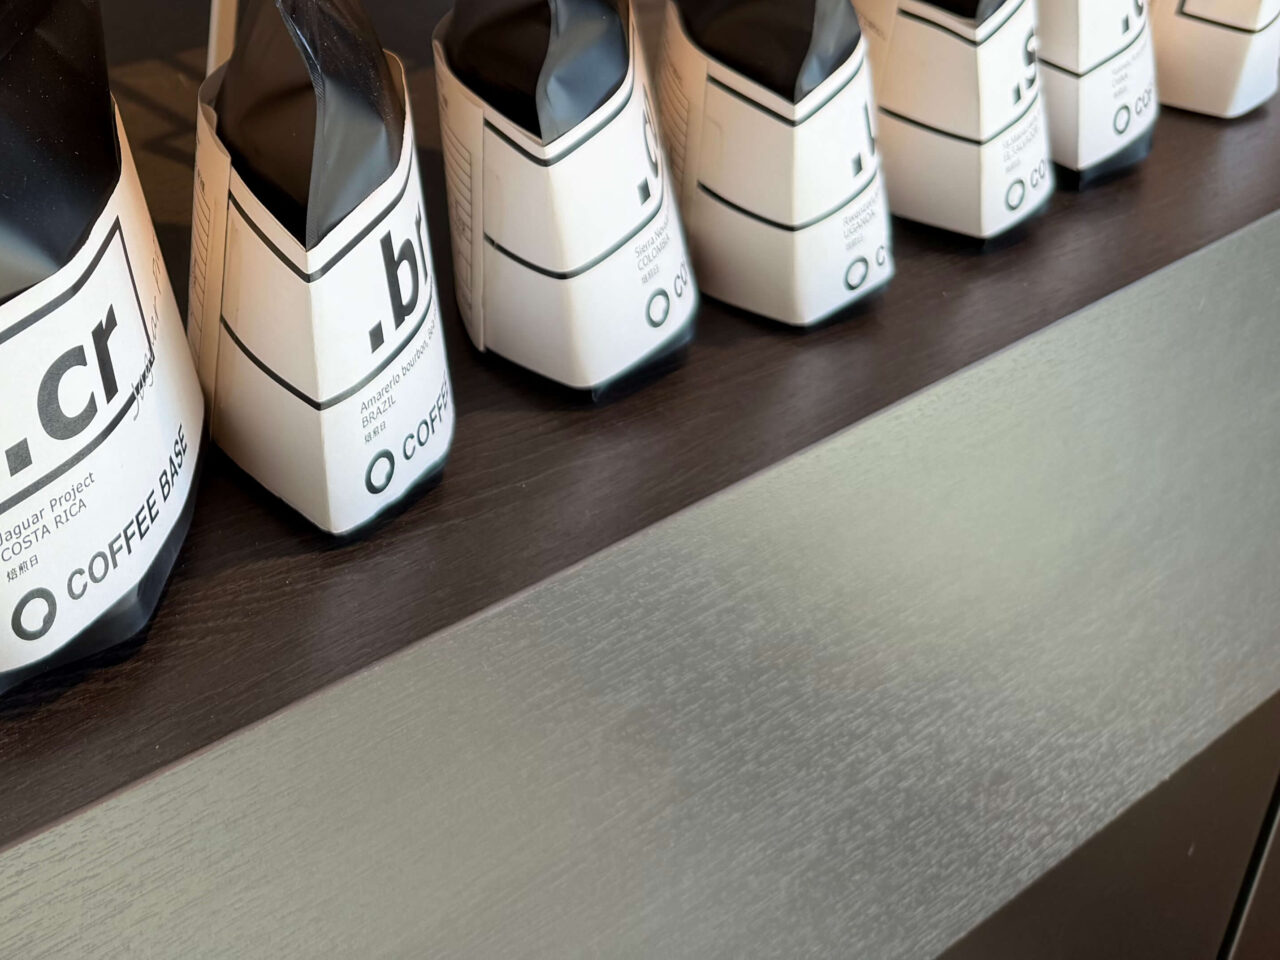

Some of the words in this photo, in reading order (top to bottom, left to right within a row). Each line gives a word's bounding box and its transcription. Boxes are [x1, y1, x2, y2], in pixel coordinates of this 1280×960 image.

[5, 303, 119, 477] .cr
[361, 396, 397, 428] BRAZIL
[49, 472, 95, 513] Project
[67, 489, 160, 600] COFFEE
[159, 424, 188, 503] BASE
[0, 524, 51, 563] COSTA
[54, 498, 87, 529] RICA
[6, 554, 39, 583] 焙煎日
